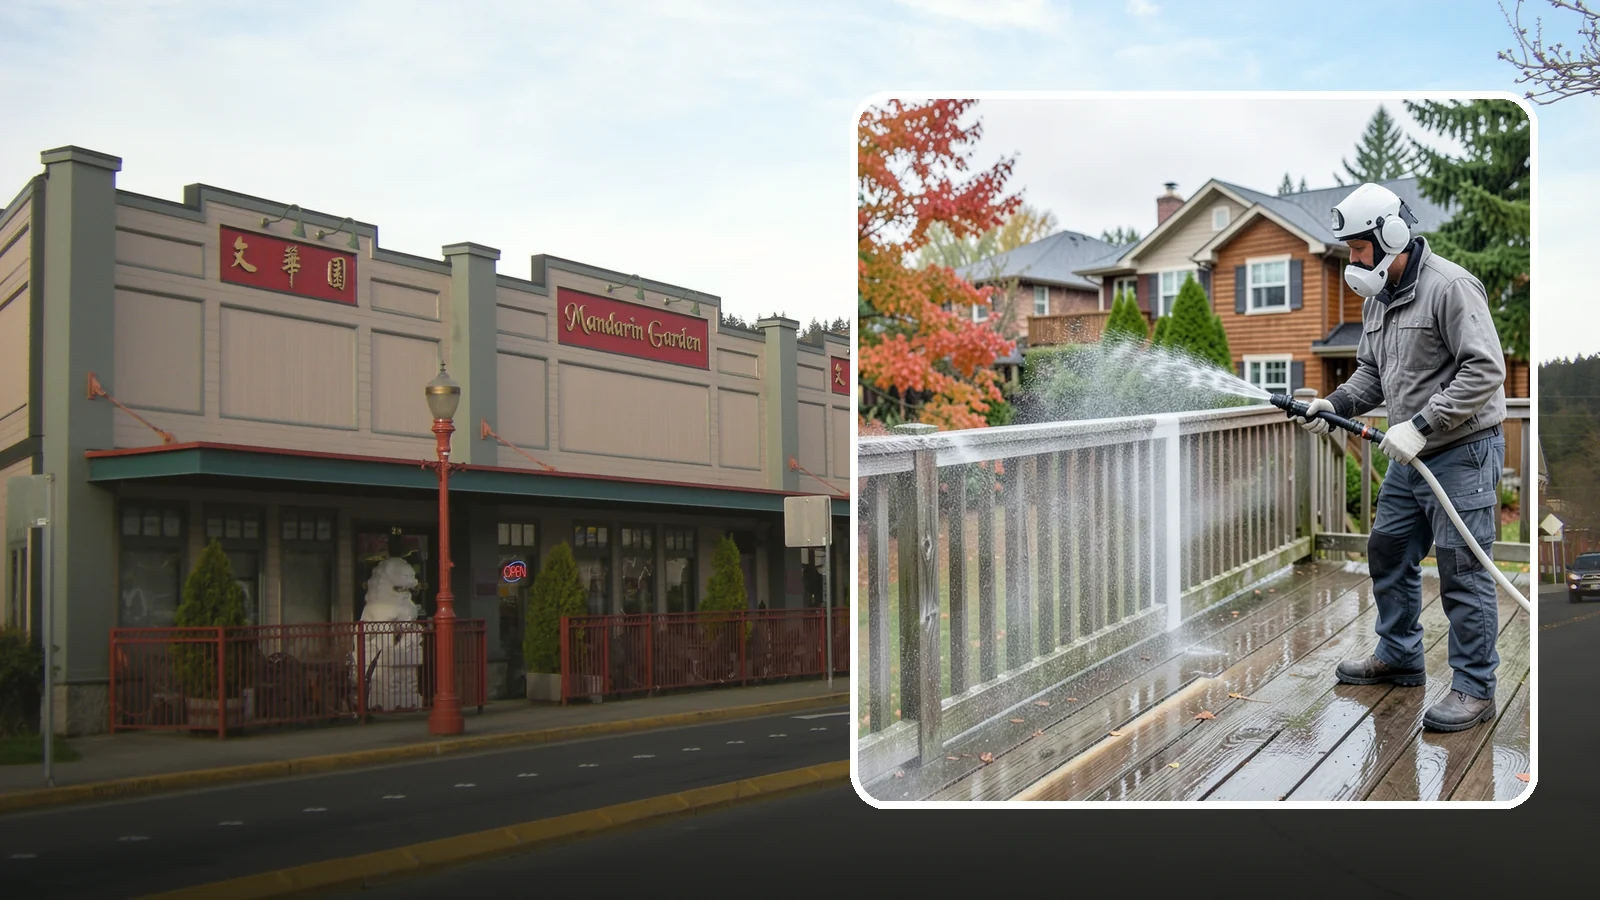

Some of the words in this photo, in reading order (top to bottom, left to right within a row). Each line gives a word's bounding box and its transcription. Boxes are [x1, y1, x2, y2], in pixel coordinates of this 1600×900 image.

[231, 235, 346, 291] 文華園
[564, 302, 644, 341] Mandarin
[647, 320, 701, 352] Garden
[503, 565, 527, 578] OPEN
